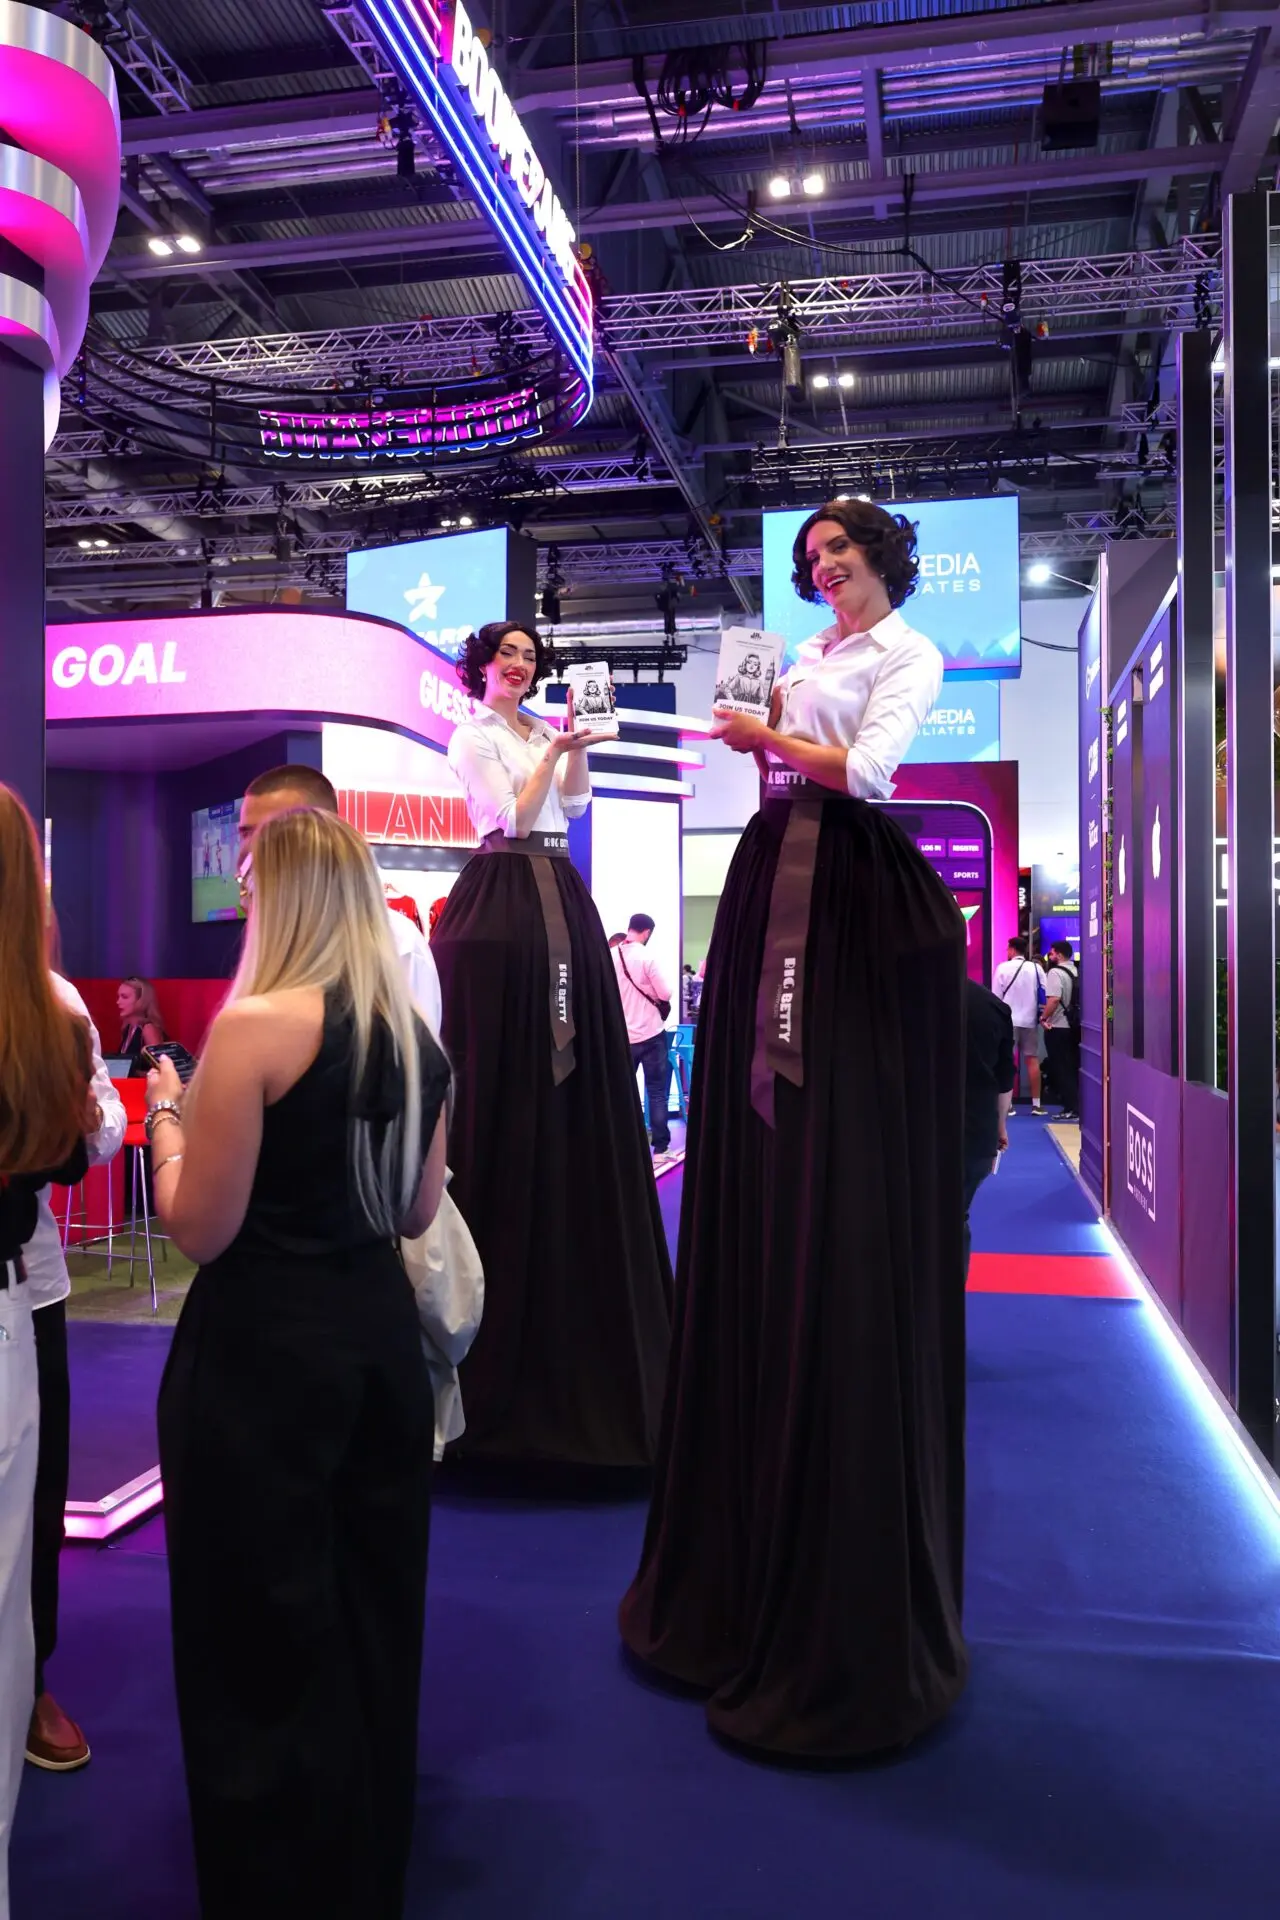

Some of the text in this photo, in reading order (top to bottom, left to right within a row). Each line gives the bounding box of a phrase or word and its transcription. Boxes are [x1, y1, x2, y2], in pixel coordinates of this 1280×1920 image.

[918, 552, 981, 577] EDIA
[920, 579, 981, 594] ATES
[52, 641, 187, 688] GOAL
[719, 703, 734, 711] JOIN
[744, 708, 766, 717] TODAY
[953, 871, 979, 879] SPORTS
[558, 963, 568, 1024] BIG BETTY
[778, 957, 796, 1043] BIG BETTY
[1129, 1124, 1153, 1193] BOSS
